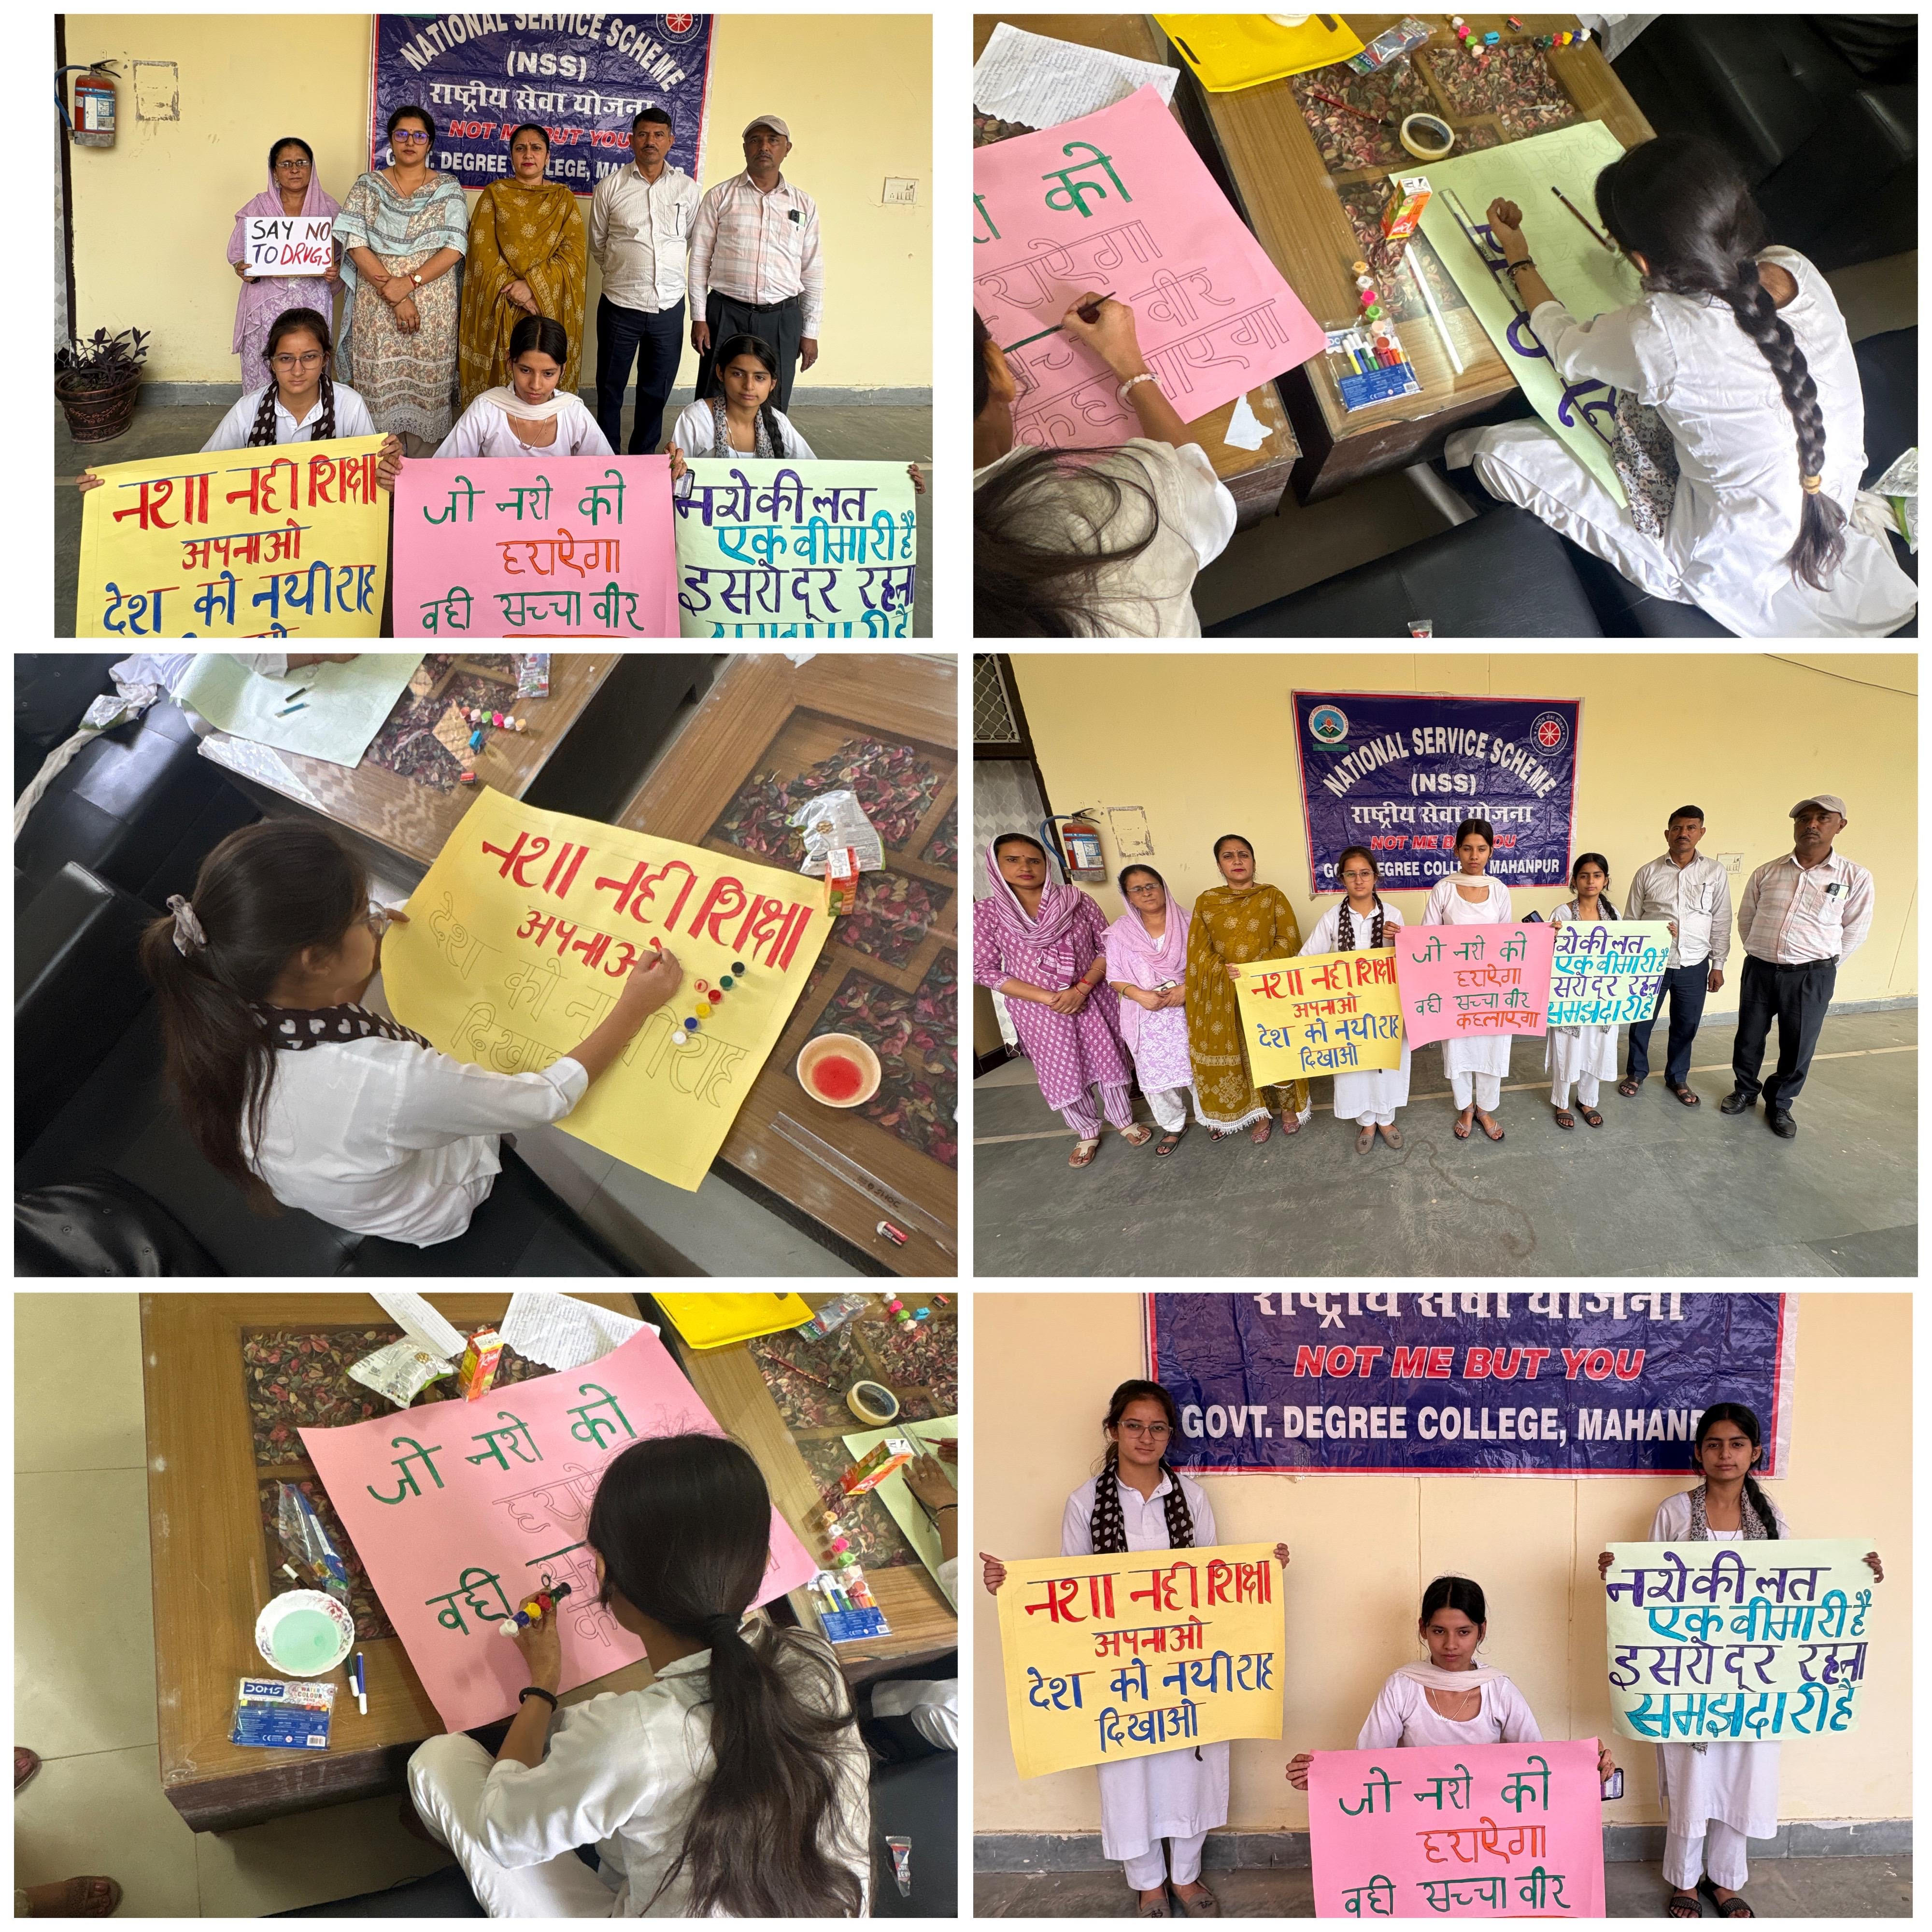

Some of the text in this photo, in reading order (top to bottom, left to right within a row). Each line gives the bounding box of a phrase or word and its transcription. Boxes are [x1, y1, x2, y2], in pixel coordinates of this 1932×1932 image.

[399, 14, 508, 72] NATIONAL
[607, 18, 686, 92] SCHEME
[507, 51, 587, 82] (NSS)
[429, 80, 510, 113] राष्ट्रीय
[516, 85, 568, 113] सेवा
[448, 120, 497, 139] NOT
[499, 124, 521, 141] M
[589, 129, 633, 149] YOU
[440, 151, 507, 172] DEGREE
[1041, 142, 1133, 217] को
[251, 220, 331, 241] SAY NO
[252, 242, 331, 266] TO DRUGS
[973, 220, 1163, 309] राऐगा
[1129, 268, 1235, 327] वीर
[113, 453, 377, 530] नशा नही शिक्षा
[424, 475, 485, 524] जो
[578, 469, 626, 526] को
[756, 469, 813, 523] की
[813, 488, 878, 523] लत
[181, 518, 313, 569] अपनाओ
[713, 525, 787, 565] एक
[791, 510, 899, 565] बीमारी
[103, 560, 377, 635] देश को नयी राह
[420, 582, 644, 634] वही सच्चा वीर
[791, 564, 916, 622] दूर रहना
[1323, 726, 1557, 799] NATIONAL SERVICE SCHEME
[1411, 773, 1477, 796] (NSS)
[1351, 801, 1534, 829] राष्ट्रीय सेवा योजना
[1370, 835, 1409, 850] NOT
[1412, 835, 1439, 850] ME
[1493, 834, 1517, 849] OU
[1380, 859, 1559, 877] EGREE MAHANPUR
[482, 831, 814, 974] नशा नही शिक्षा
[1412, 936, 1447, 963] जो
[1499, 931, 1527, 962] को
[1553, 955, 1593, 975] एक
[1597, 948, 1659, 975] बीमारी
[1556, 926, 1651, 954] शे की लत
[429, 891, 750, 1108] देश को राह
[1250, 956, 1396, 999] नशा नही शिक्षा
[1414, 988, 1530, 1015] वही सच्चा वीर
[1591, 975, 1664, 1000] दूर रहना
[1291, 992, 1362, 1018] अपनाओ
[1456, 1011, 1541, 1029] कहलाएगा
[1257, 1013, 1399, 1048] देश को नयी राह
[1297, 1042, 1362, 1072] दिखाओ
[1294, 1345, 1646, 1380] NOT ME BUT YOU
[367, 1437, 444, 1505] जो
[567, 1384, 637, 1449] को
[1182, 1405, 1705, 1448] GOVT. DEGREE COLLEGE, MAHANP
[425, 1568, 513, 1635] वही
[1024, 1559, 1271, 1623] नशा नही शिक्षा
[1692, 1550, 1756, 1604] की
[1756, 1567, 1832, 1603] लत
[1091, 1615, 1213, 1657] अपनाओ
[1643, 1605, 1723, 1642] एक
[1729, 1590, 1851, 1641] बीमारी
[245, 1684, 282, 1694] DOMS
[1027, 1650, 1275, 1711] देश को नयी राह
[1724, 1642, 1868, 1692] दूर रहना
[1094, 1698, 1207, 1753] दिखाओ
[1625, 1682, 1830, 1739] समझदारी
[1339, 1766, 1402, 1816] जो
[1501, 1755, 1552, 1813] को
[1342, 1866, 1571, 1918] वही सच्चा वीर
